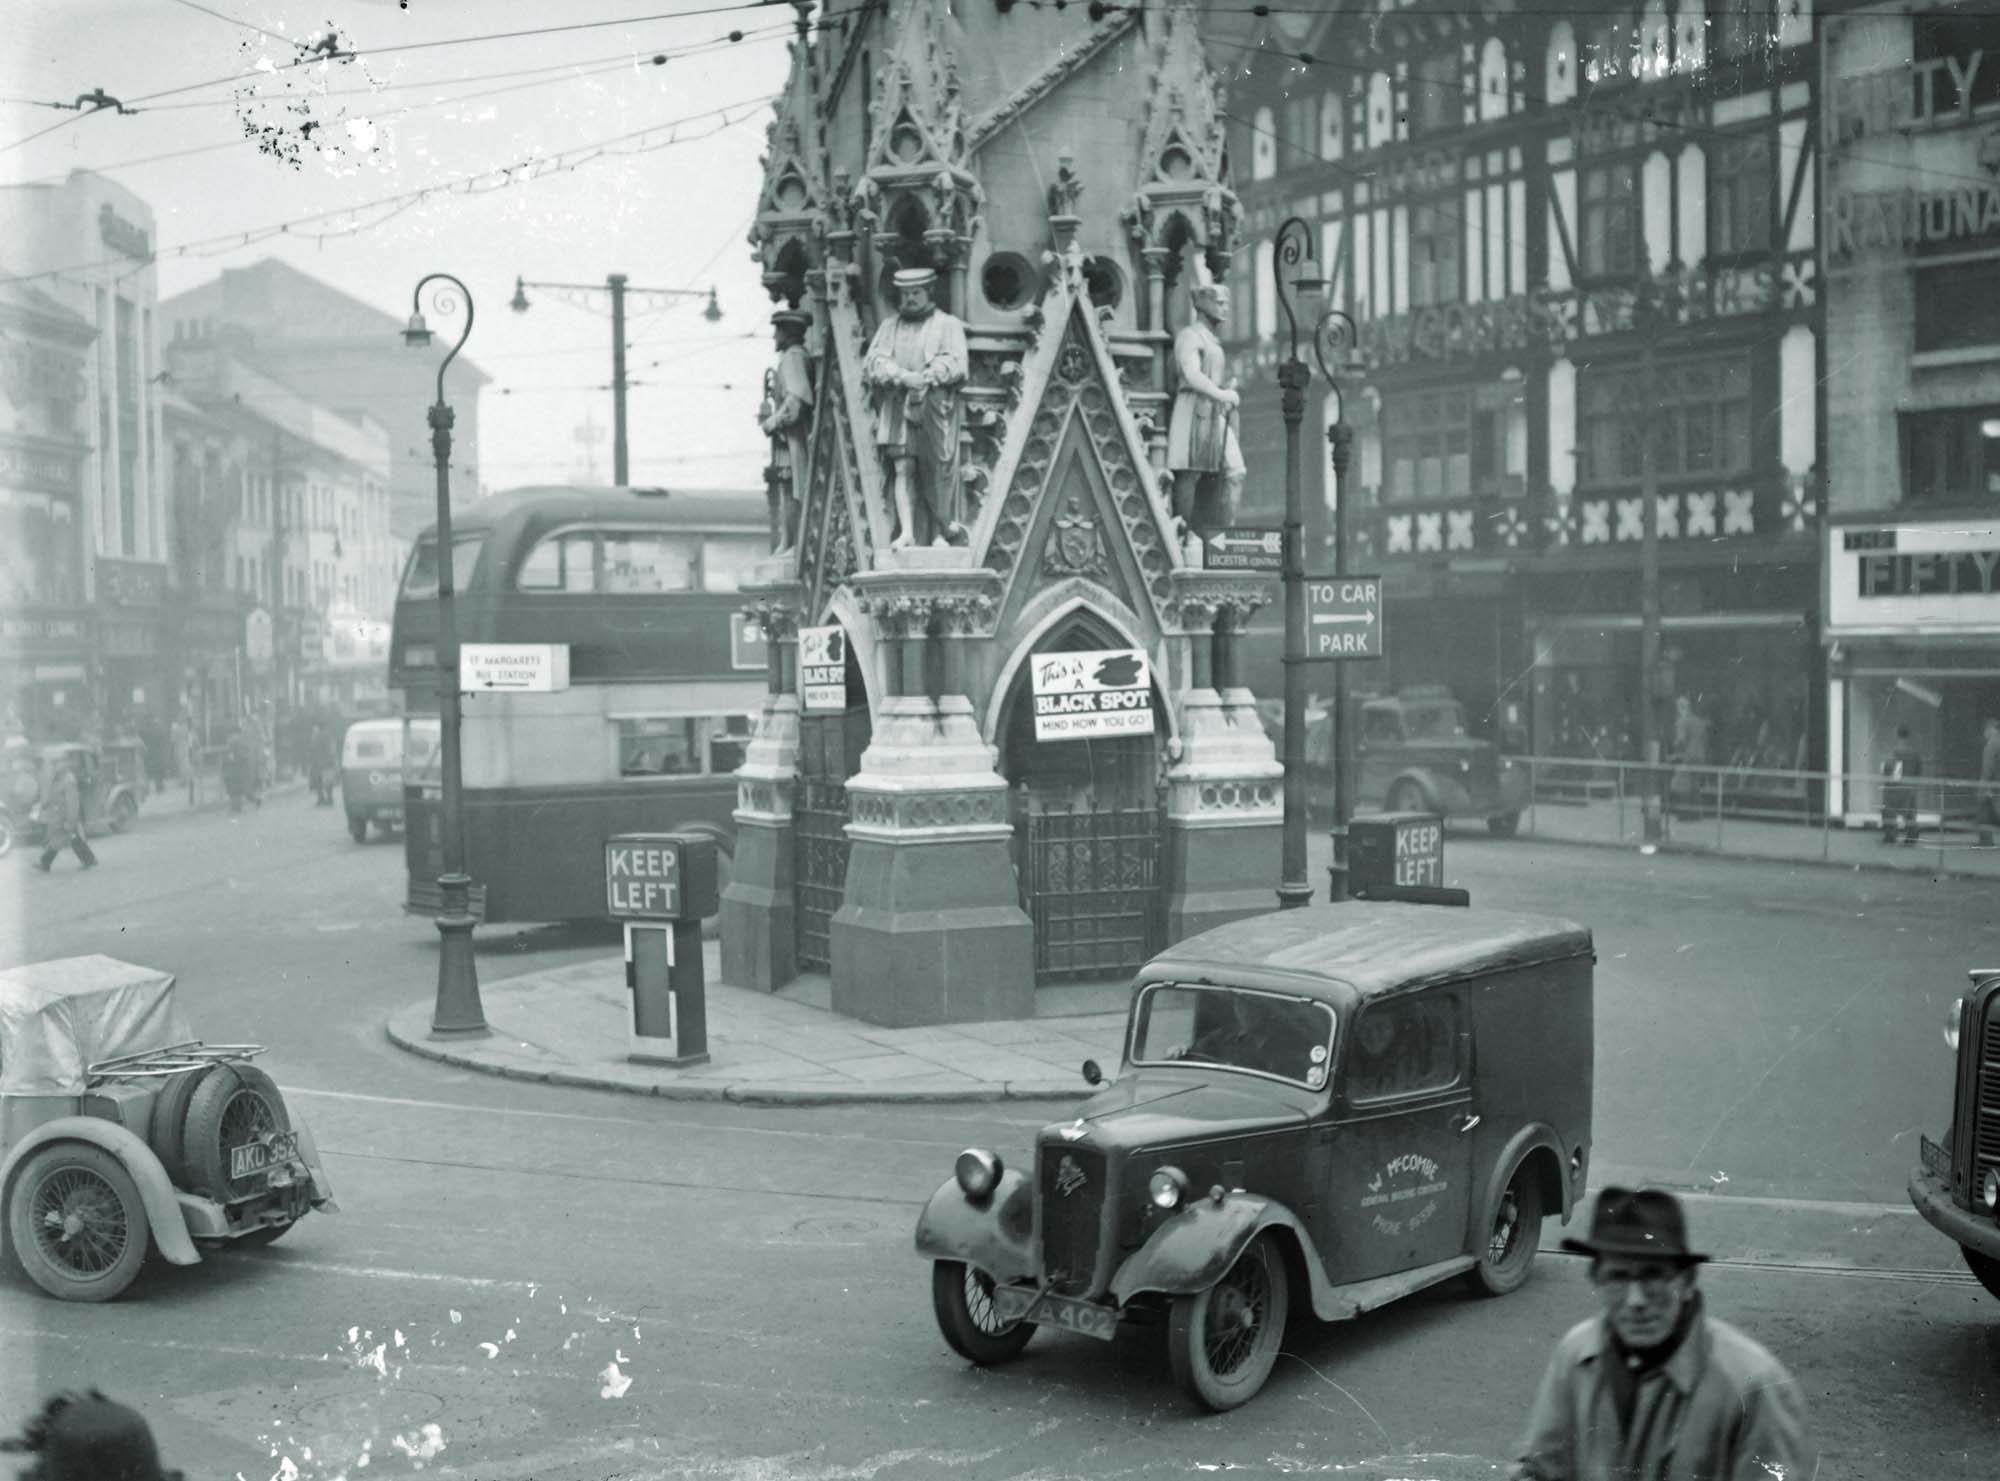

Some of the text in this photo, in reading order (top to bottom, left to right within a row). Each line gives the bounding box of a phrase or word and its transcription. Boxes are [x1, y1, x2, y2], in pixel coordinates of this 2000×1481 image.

[1208, 553, 1249, 567] LEICESTER
[1865, 551, 2000, 597] FIFTY
[1310, 584, 1376, 603] TO CAR
[1319, 633, 1368, 653] PARK
[498, 670, 537, 680] STATION
[1040, 657, 1084, 688] This is
[1074, 679, 1084, 689] A
[1036, 690, 1150, 714] BLACK SPOT
[1042, 719, 1069, 731] MIND
[1072, 718, 1097, 729] HOW
[1103, 716, 1125, 728] YOU
[1395, 825, 1439, 857] KEEP
[611, 849, 676, 877] KEEP
[1395, 857, 1438, 886] LEFT
[612, 881, 677, 909] LEFT
